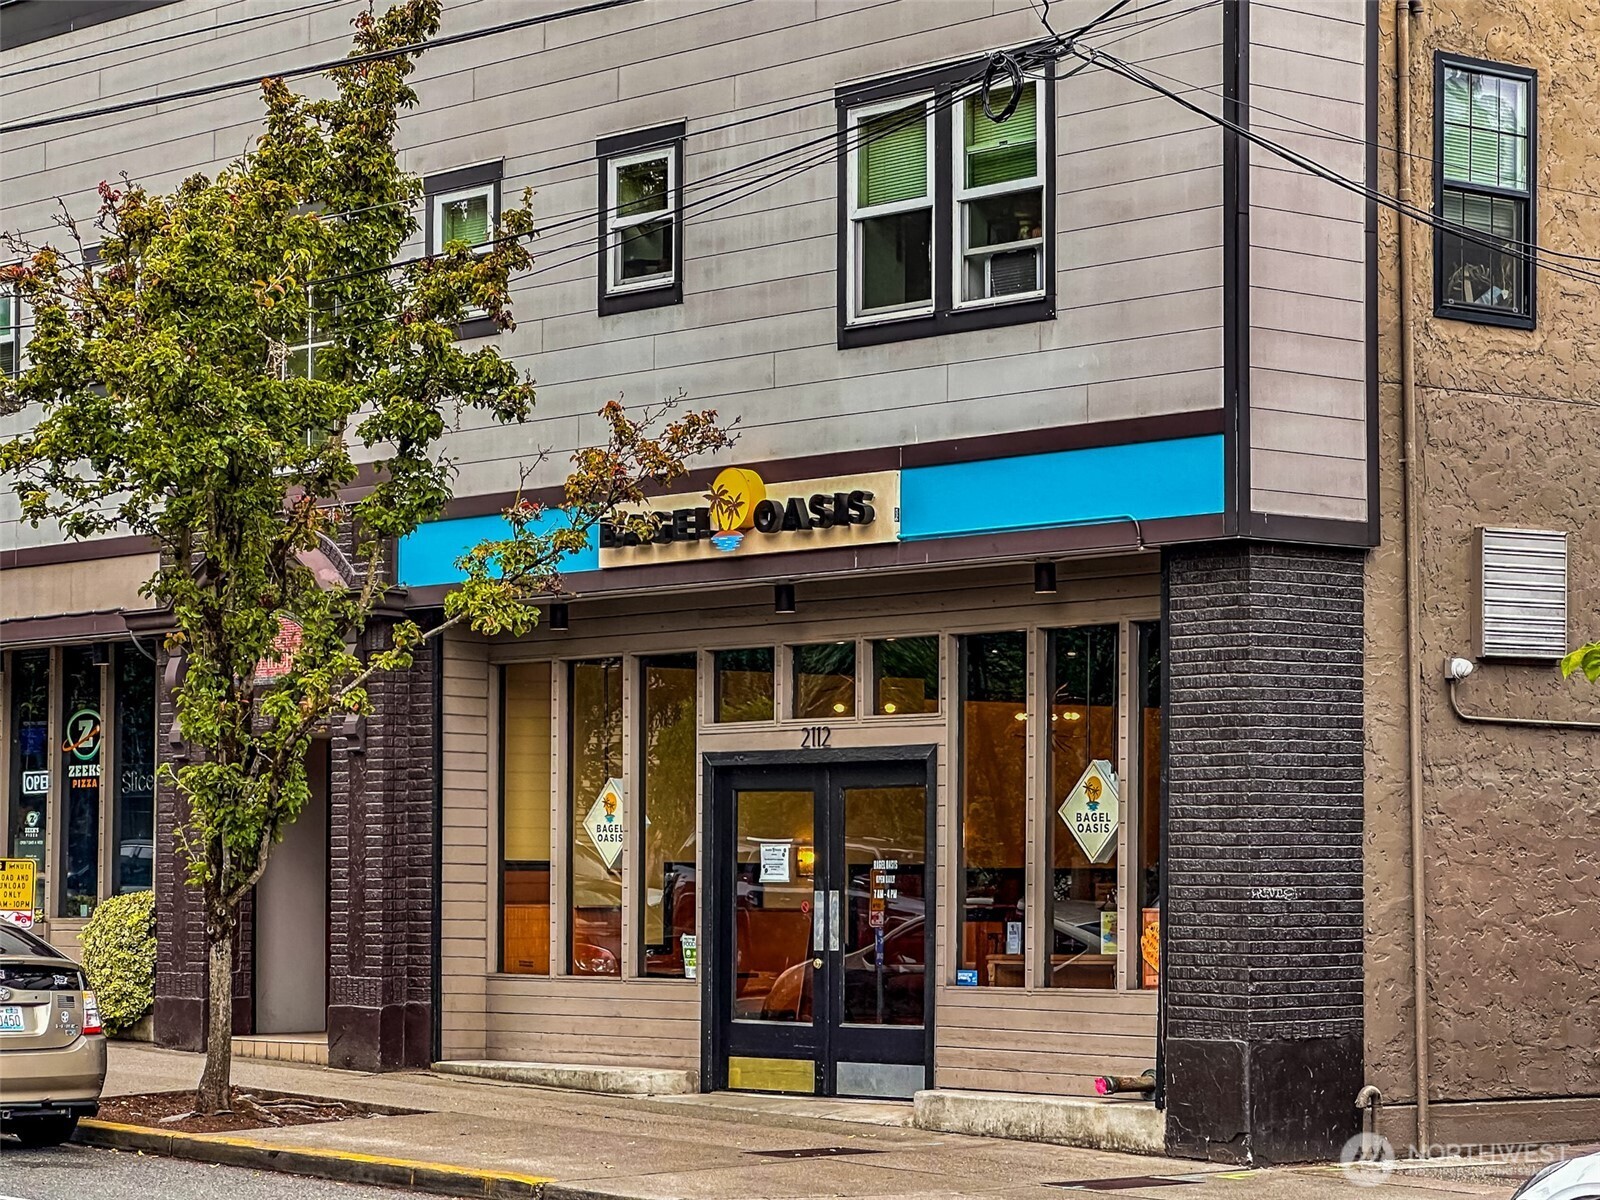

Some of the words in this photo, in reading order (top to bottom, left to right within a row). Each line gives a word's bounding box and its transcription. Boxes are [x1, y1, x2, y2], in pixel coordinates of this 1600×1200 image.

[600, 507, 720, 548] BAGEL
[753, 490, 876, 533] OASIS
[800, 726, 832, 748] 2112
[68, 764, 100, 778] ZEEKS
[25, 775, 49, 791] OPE
[72, 779, 98, 789] PIZZA
[1076, 812, 1112, 823] BAGEL
[596, 824, 624, 833] BAGEL
[1077, 823, 1110, 833] OASIS
[597, 833, 624, 843] OASIS
[0, 874, 14, 882] OAD
[17, 874, 29, 882] AND
[13, 900, 30, 908] 10PM
